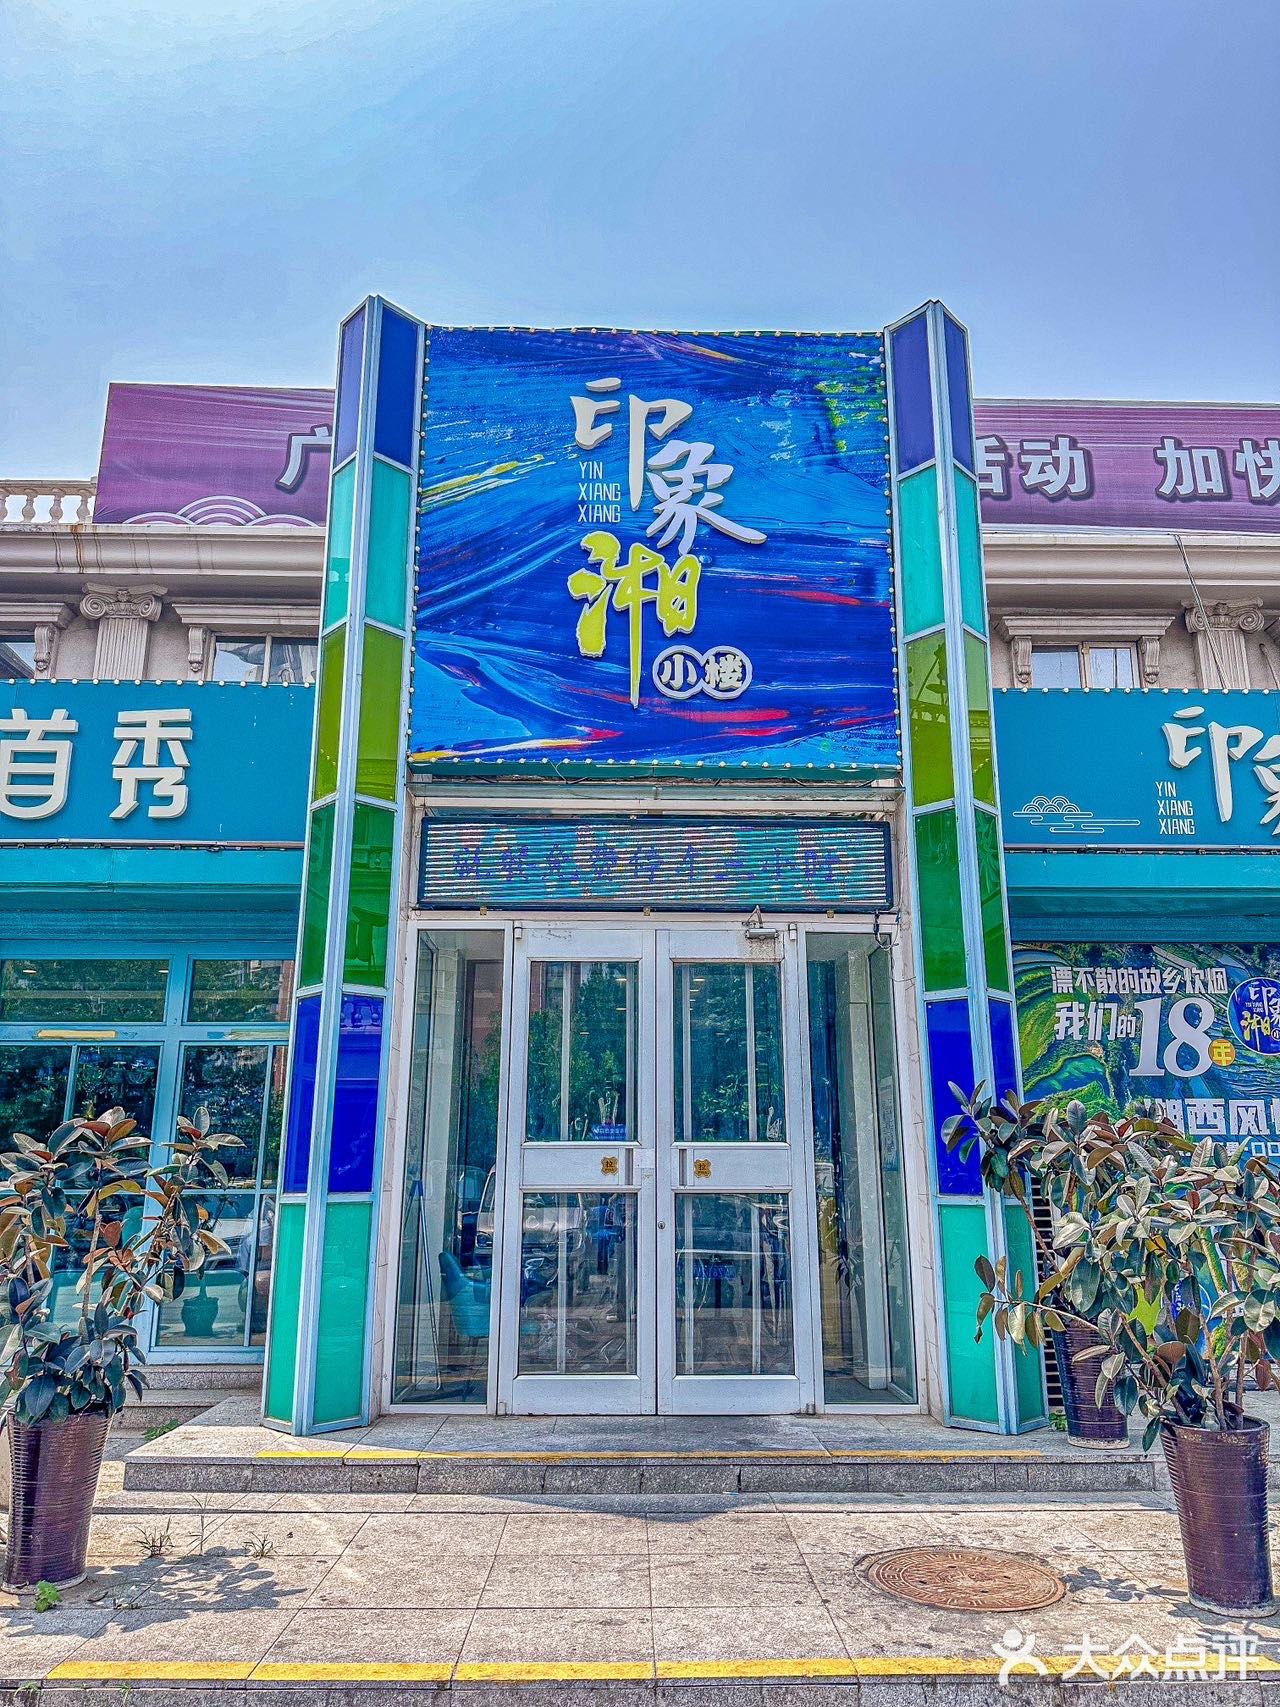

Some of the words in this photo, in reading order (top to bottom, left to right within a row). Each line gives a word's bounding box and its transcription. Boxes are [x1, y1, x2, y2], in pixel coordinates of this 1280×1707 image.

[570, 377, 768, 555] 印象
[579, 461, 603, 480] YIN
[578, 482, 621, 502] XIANG
[577, 504, 621, 524] XIANG
[567, 531, 702, 709] 湘
[657, 651, 745, 693] 小楼
[0, 708, 193, 820] 首秀
[1155, 781, 1177, 798] YIN
[1157, 800, 1194, 816] XIANG
[1159, 818, 1195, 835] XIANG
